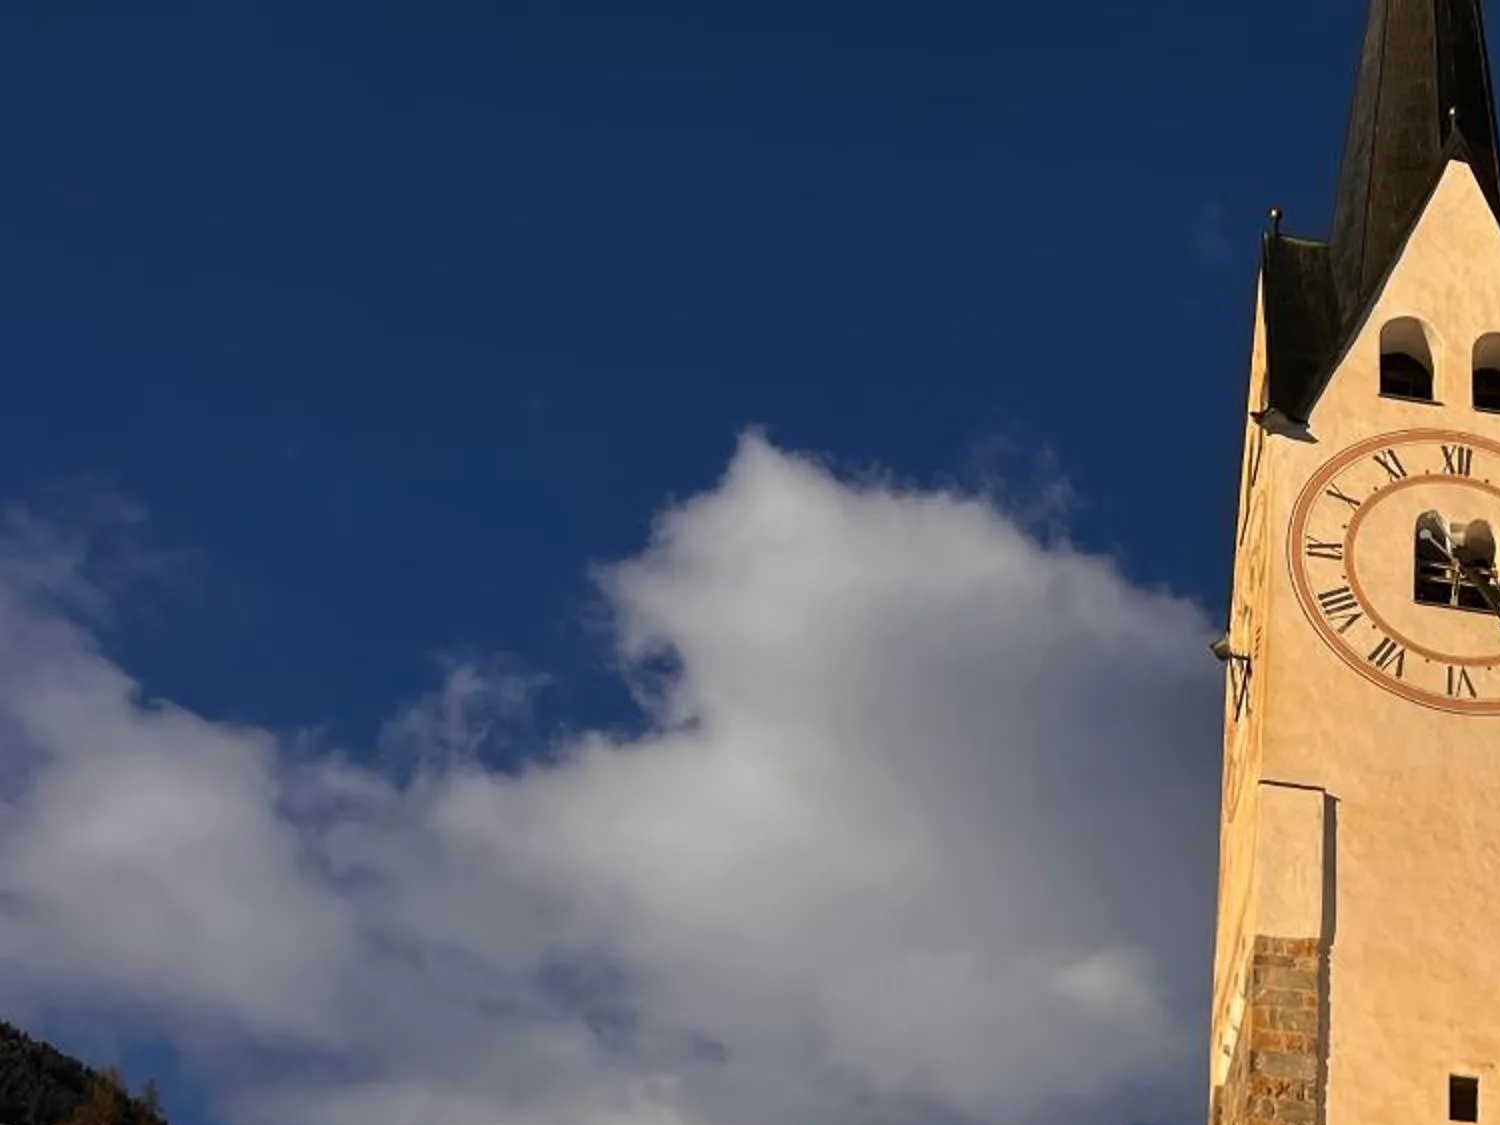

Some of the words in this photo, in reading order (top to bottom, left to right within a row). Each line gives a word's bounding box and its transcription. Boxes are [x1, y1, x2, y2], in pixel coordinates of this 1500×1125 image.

[1373, 449, 1407, 482] XI
[1441, 445, 1473, 477] XII
[1326, 483, 1361, 512] X
[1305, 535, 1343, 561] IX
[1318, 586, 1364, 634] VIII
[1367, 637, 1406, 679] VII
[1447, 665, 1477, 699] VI
